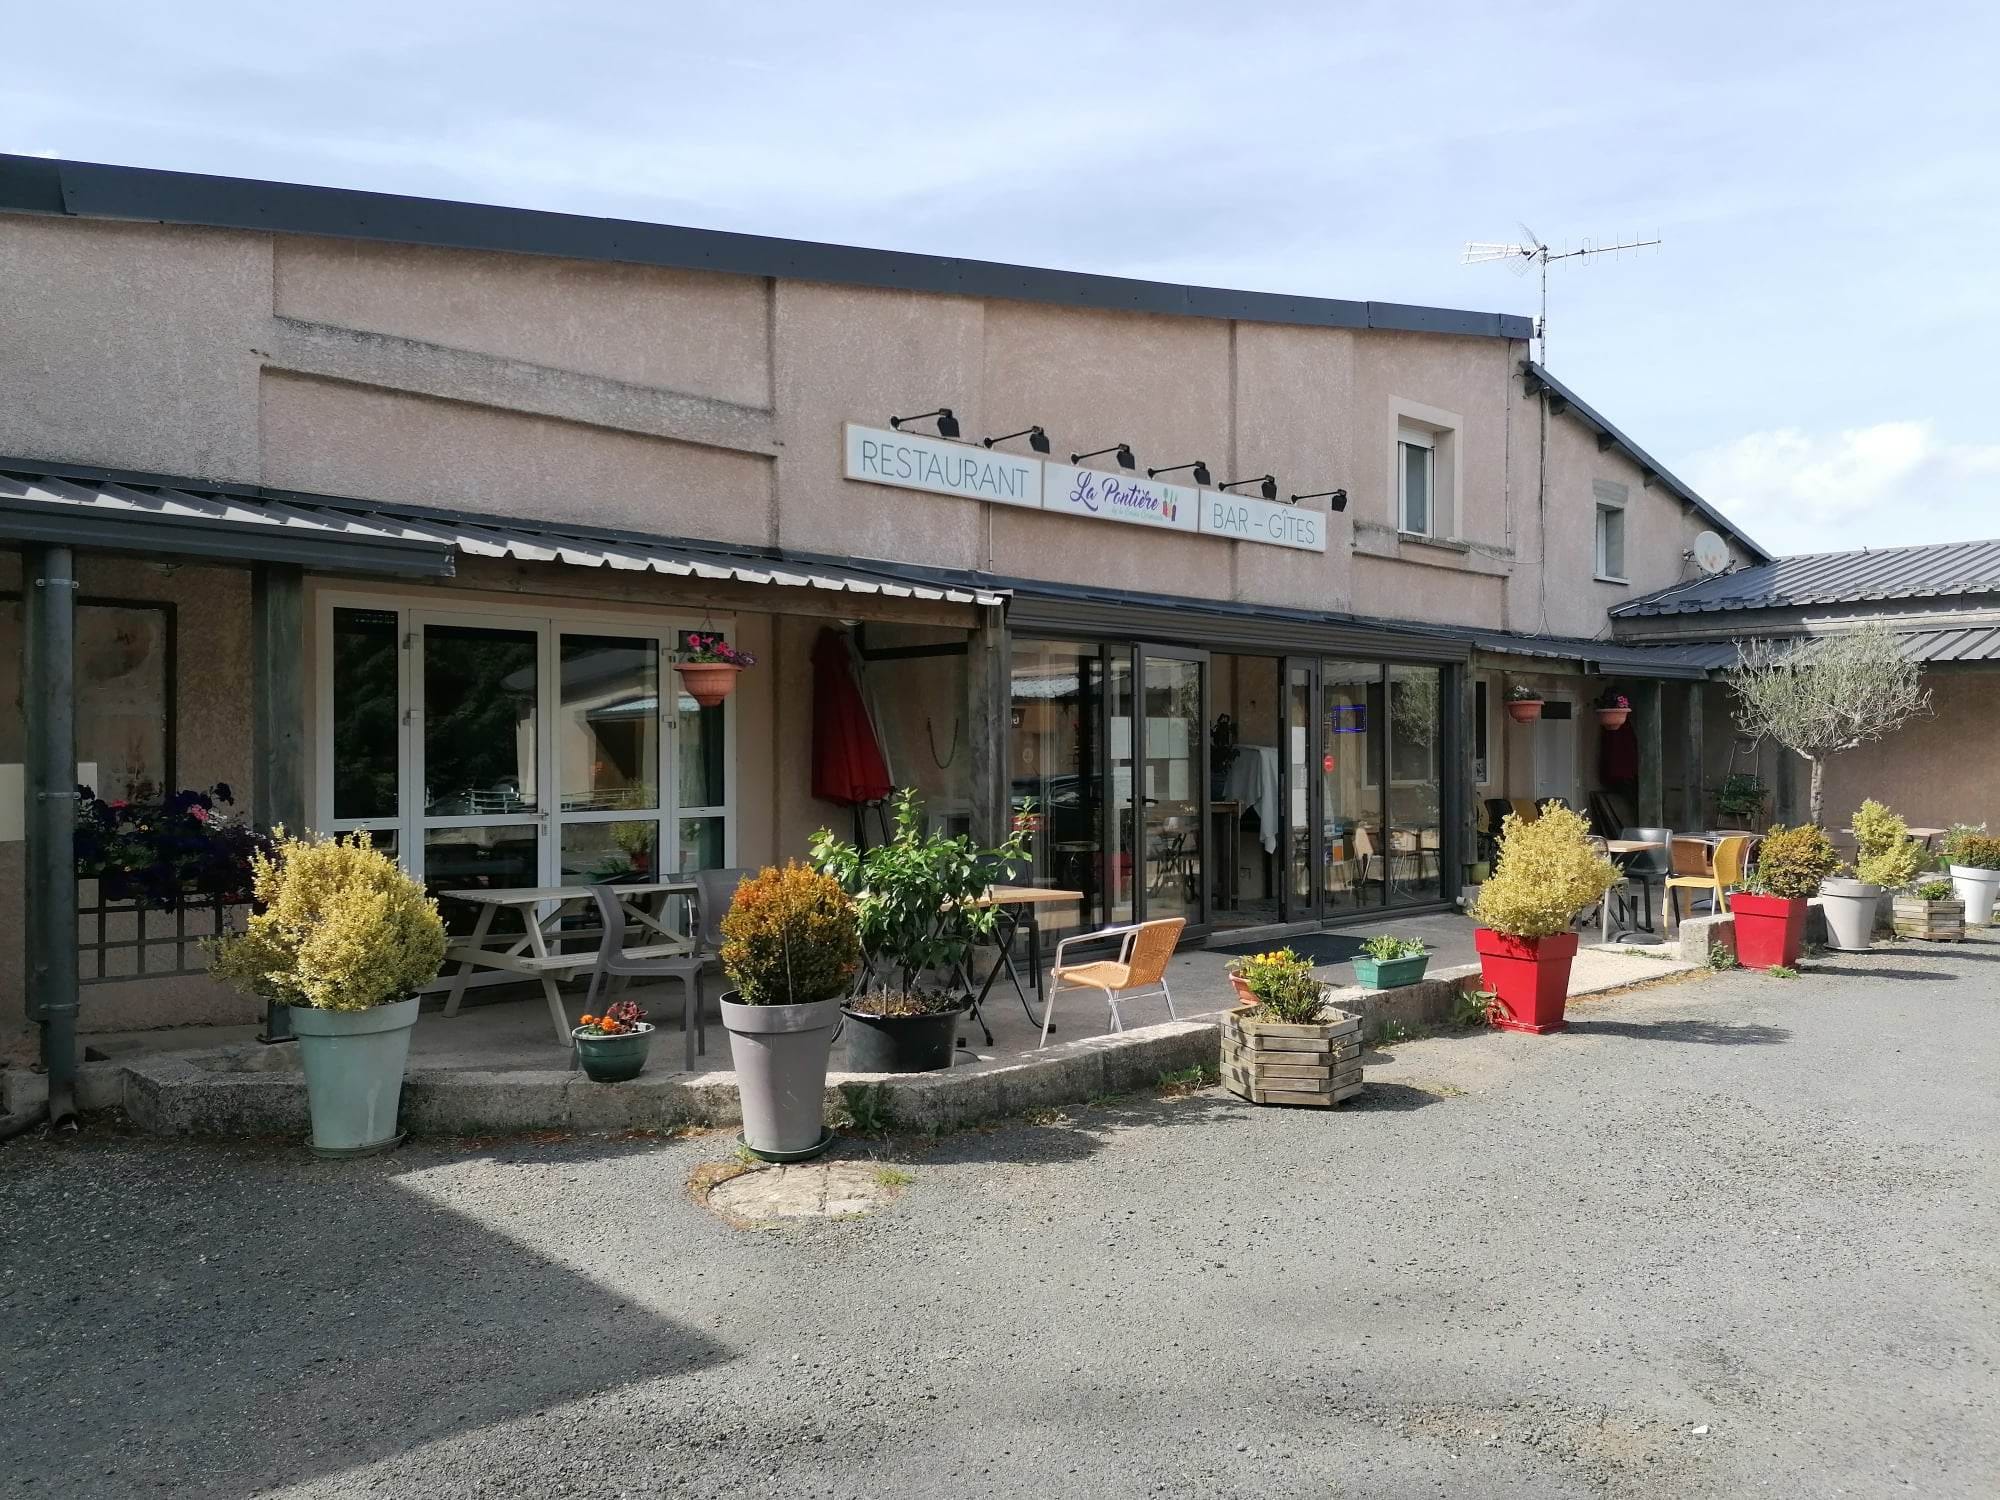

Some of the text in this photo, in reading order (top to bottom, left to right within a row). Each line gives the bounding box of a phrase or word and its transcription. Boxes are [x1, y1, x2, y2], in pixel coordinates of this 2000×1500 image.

[862, 440, 1030, 498] RESTAURANT
[1069, 471, 1099, 512] La
[1213, 502, 1249, 534] BAR
[1268, 507, 1315, 545] GÎTES
